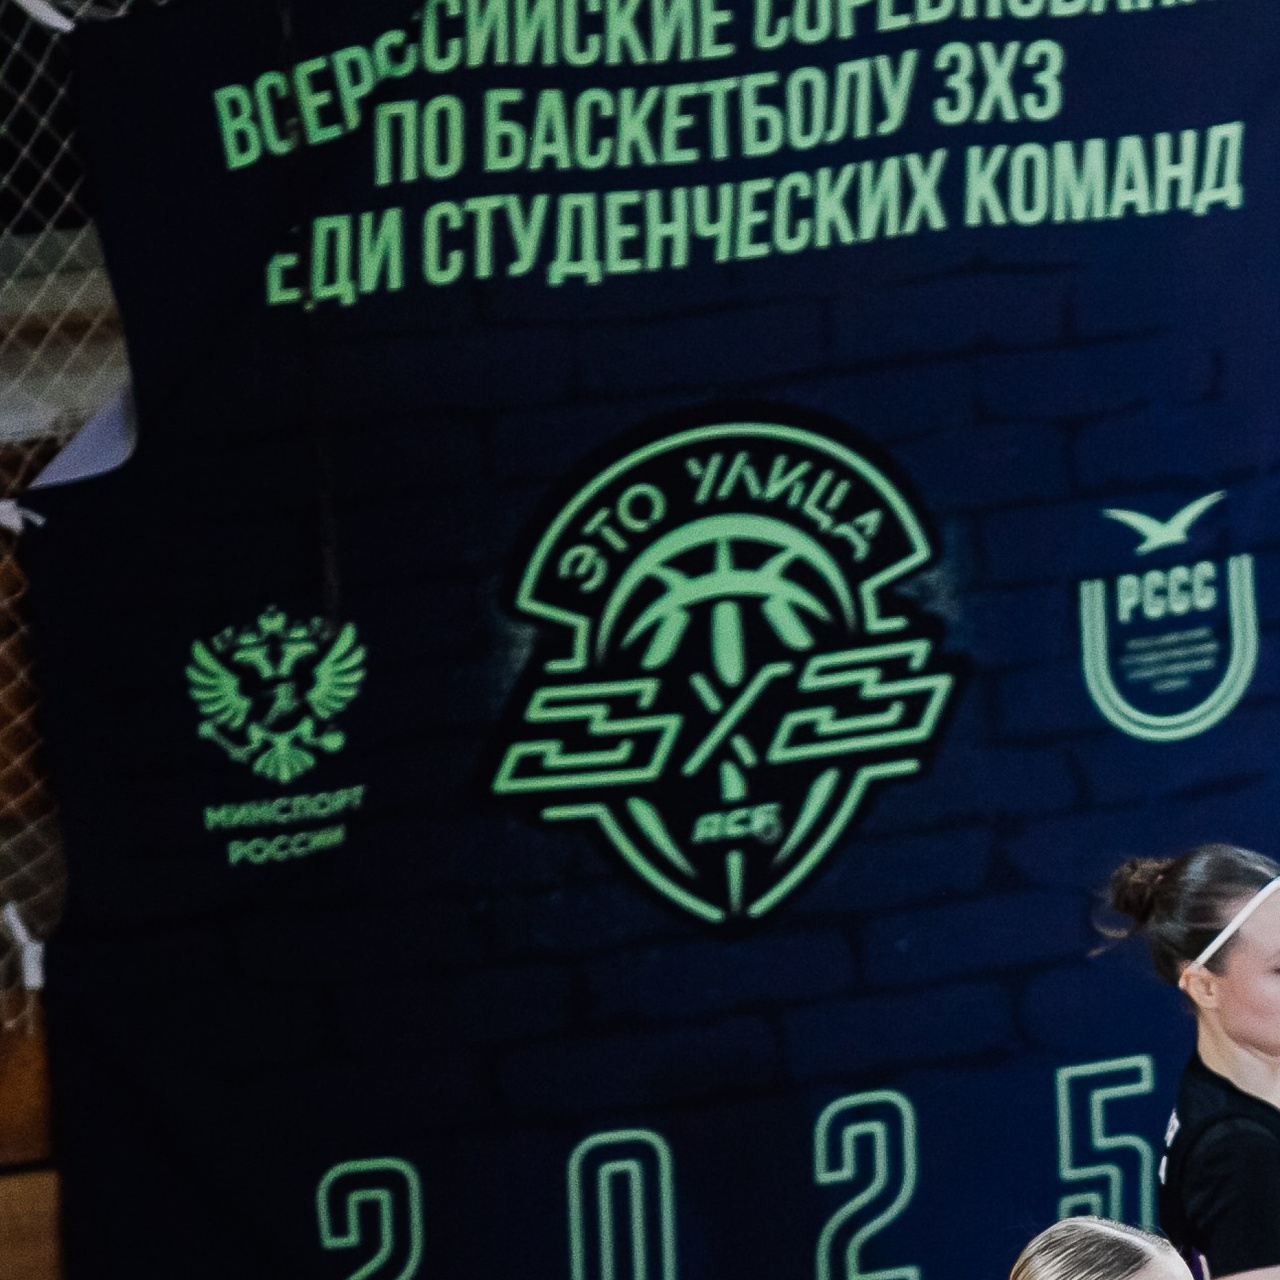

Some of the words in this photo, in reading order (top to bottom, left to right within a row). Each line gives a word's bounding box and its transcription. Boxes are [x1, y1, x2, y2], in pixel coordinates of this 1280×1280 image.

[374, 95, 465, 187] ПО
[484, 50, 918, 172] БАСКЕТБОЛУ
[932, 39, 1065, 126] 3Х3
[423, 147, 947, 287] СТУДЕНЧЕСКИХ
[964, 120, 1245, 227] КОМАНД
[558, 483, 668, 592] ЭТО
[685, 450, 884, 562] УЛИЦА
[1116, 560, 1218, 624] РССС
[203, 784, 365, 830] МИНСПОРТ
[227, 825, 346, 866] РОССИИ
